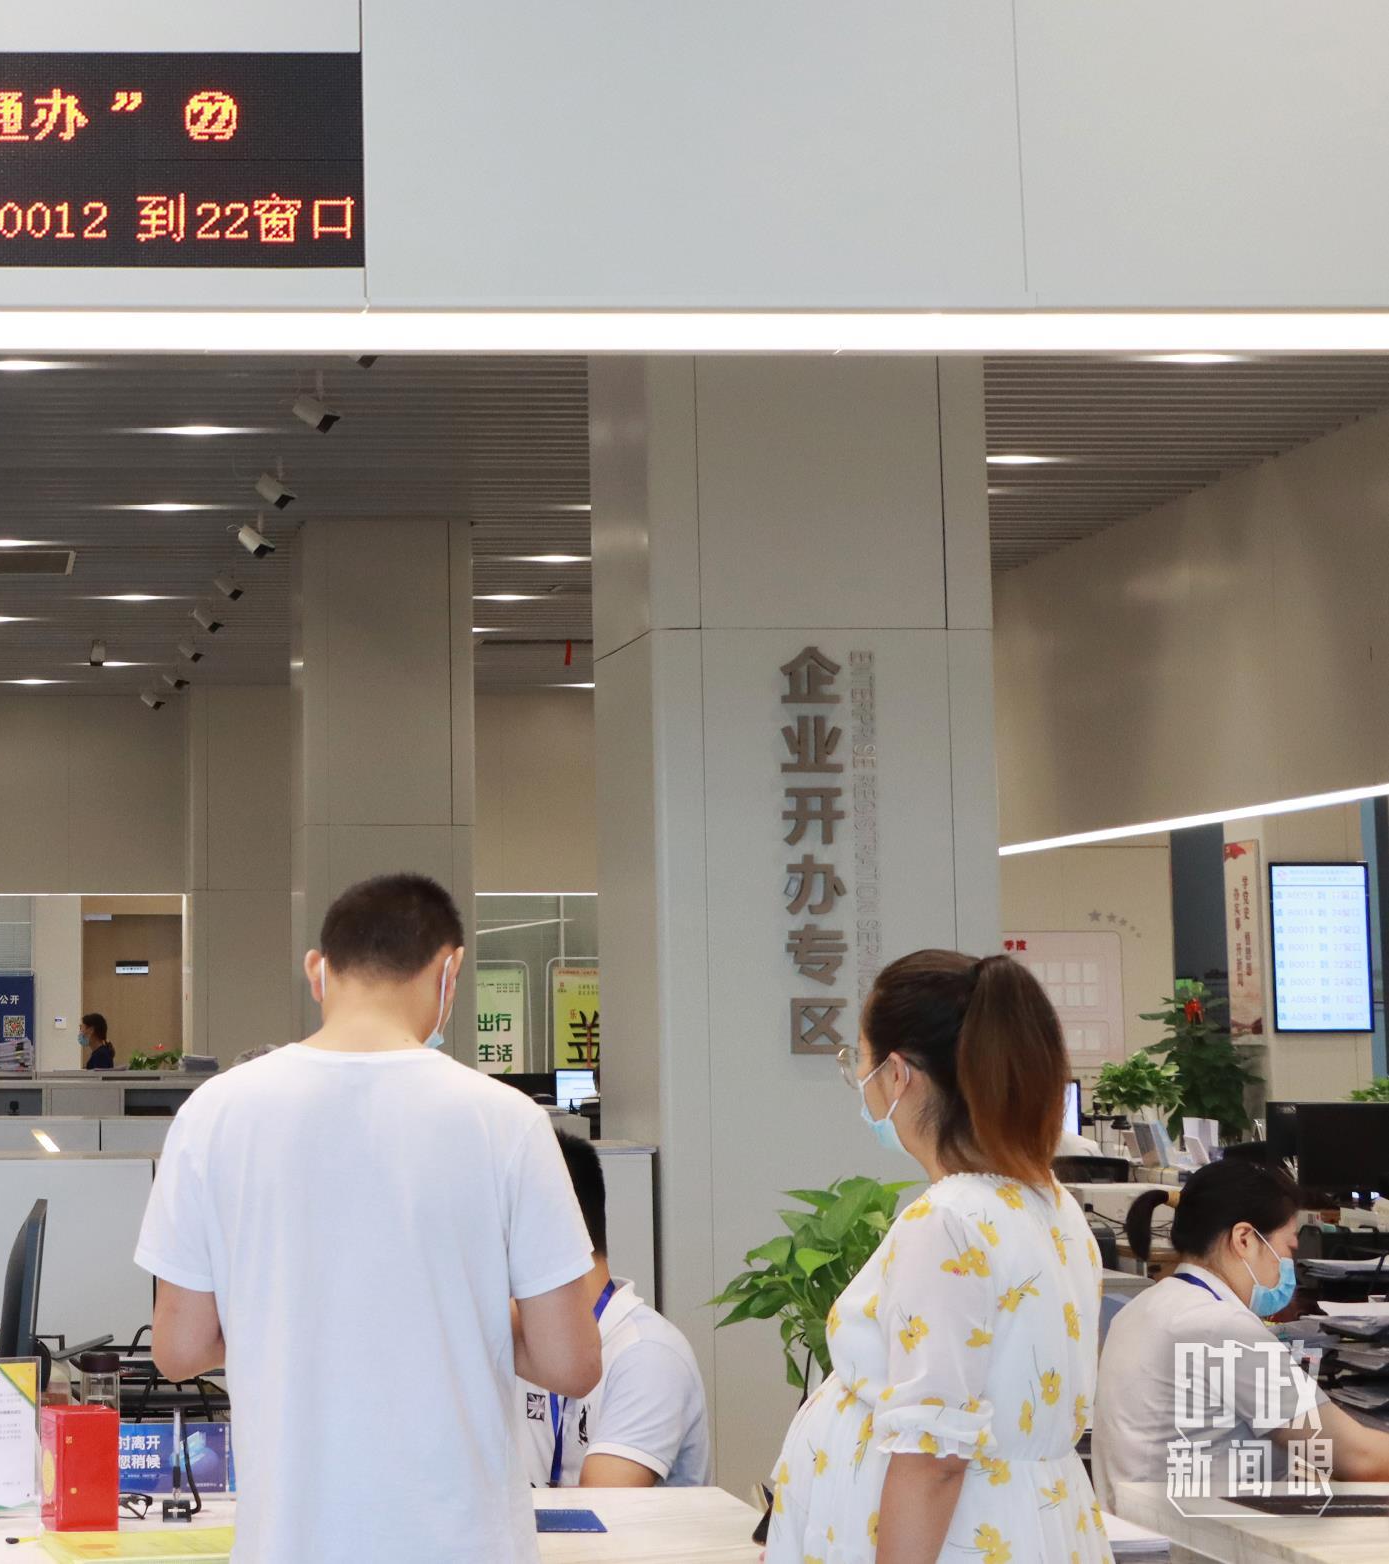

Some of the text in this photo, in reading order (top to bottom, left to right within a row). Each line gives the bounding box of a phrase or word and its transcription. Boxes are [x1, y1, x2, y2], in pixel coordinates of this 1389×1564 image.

[780, 646, 850, 1056] 企业开办专区
[477, 1013, 512, 1032] 出行
[478, 1044, 513, 1062] 生活
